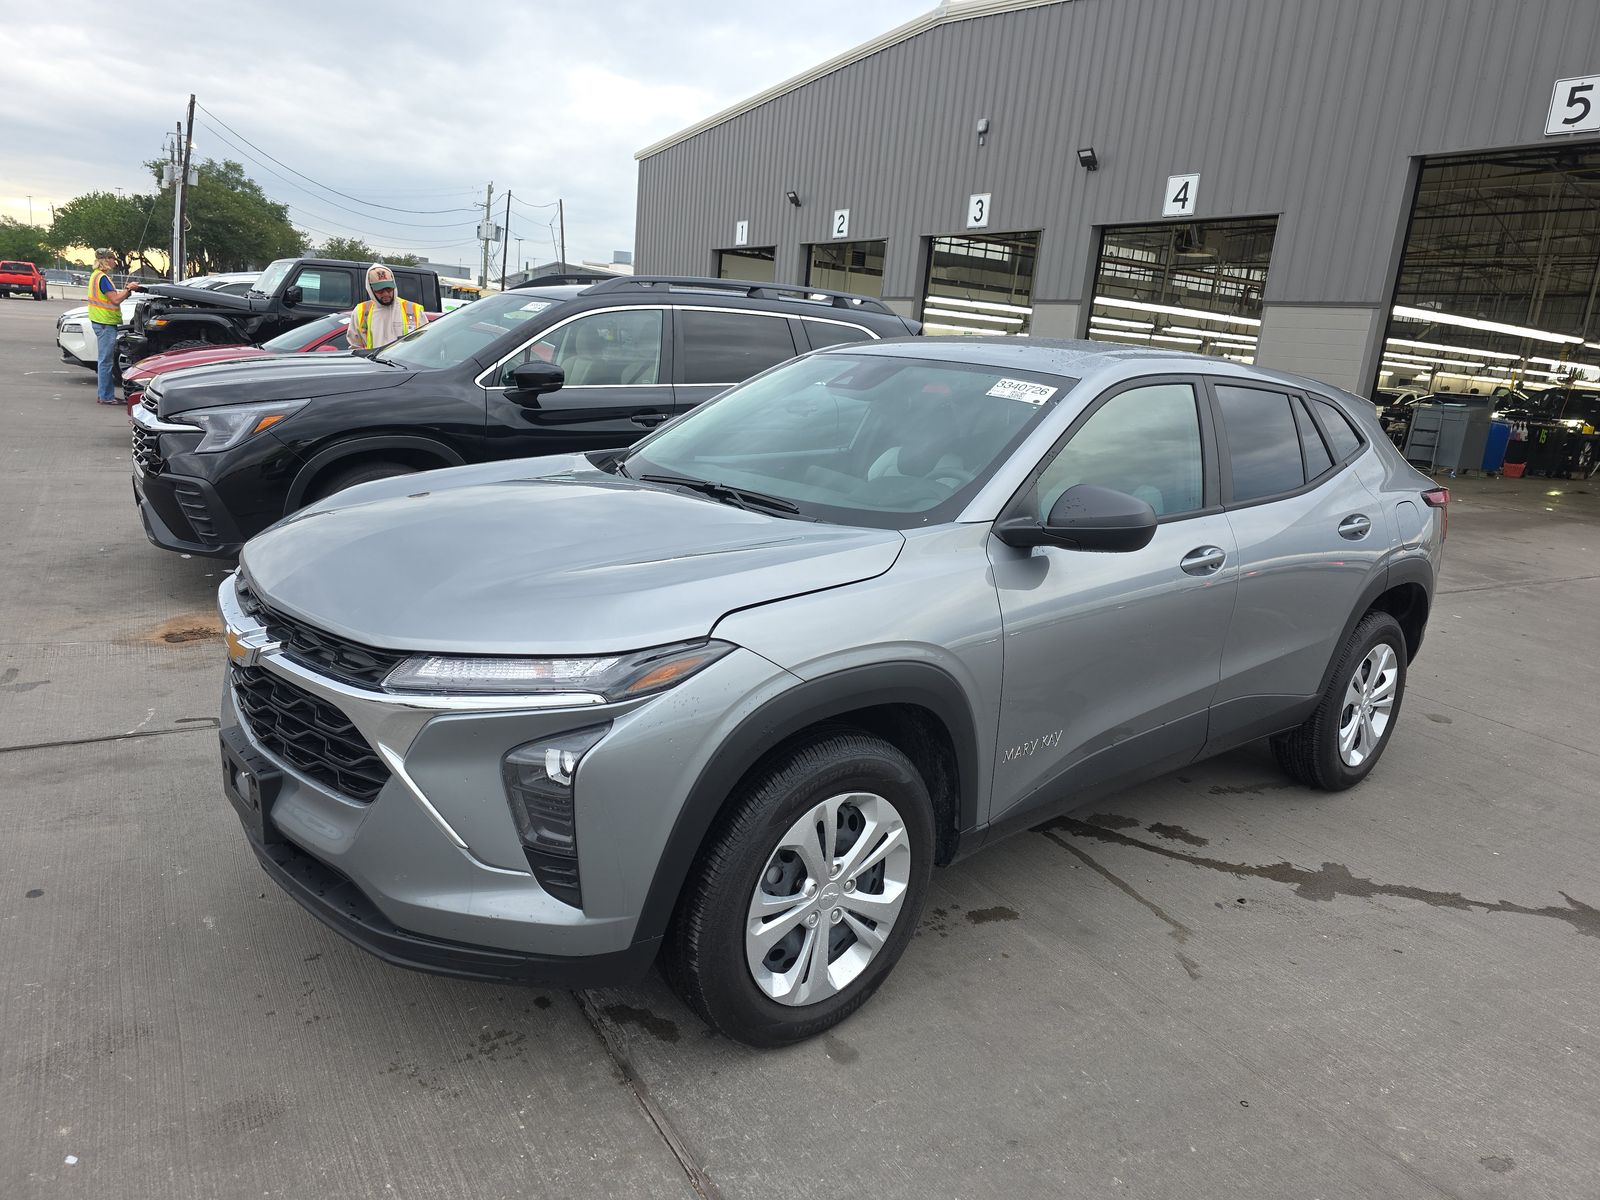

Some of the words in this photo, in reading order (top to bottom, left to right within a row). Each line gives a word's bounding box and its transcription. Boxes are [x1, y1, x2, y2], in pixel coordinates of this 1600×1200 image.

[1562, 84, 1594, 125] 5
[1172, 181, 1189, 209] 4
[973, 199, 984, 223] 3
[740, 225, 744, 241] 1
[836, 214, 846, 234] 2
[996, 380, 1050, 395] 3340726
[1002, 738, 1039, 764] MARY
